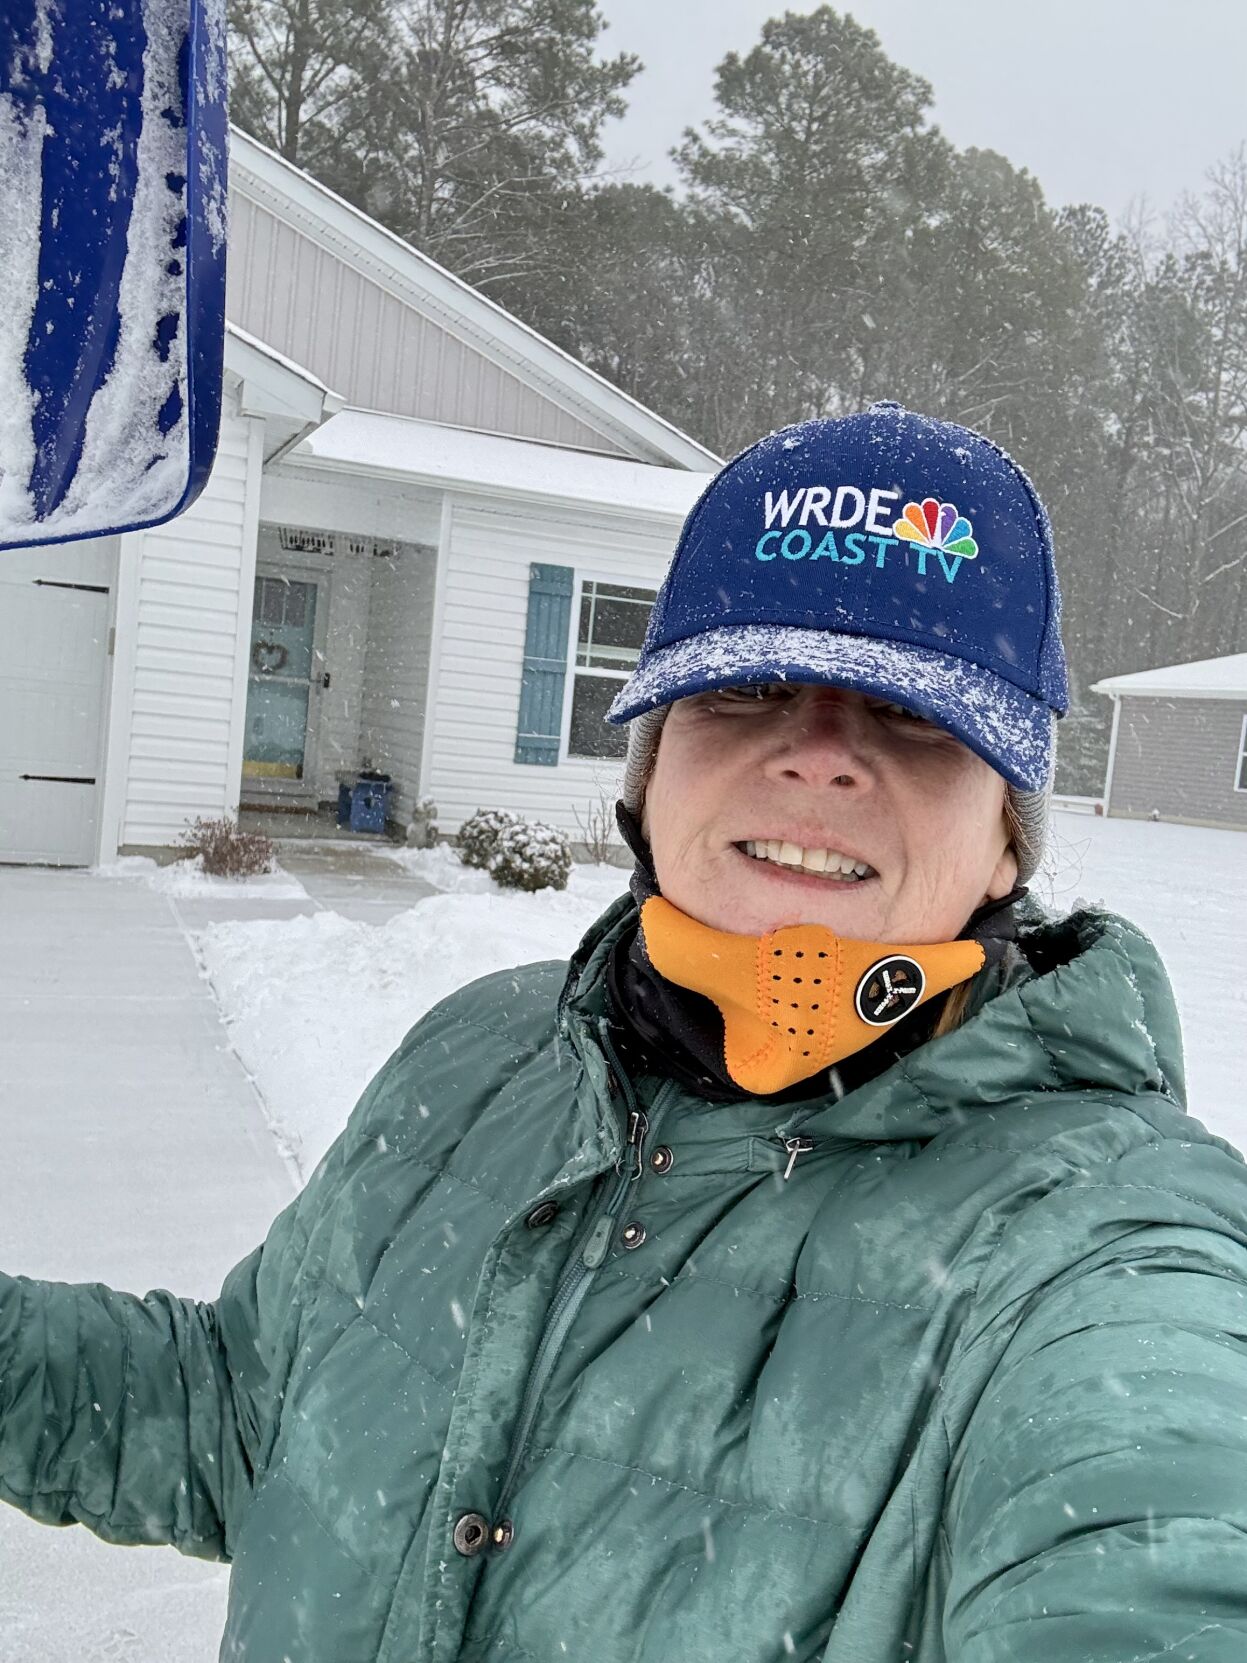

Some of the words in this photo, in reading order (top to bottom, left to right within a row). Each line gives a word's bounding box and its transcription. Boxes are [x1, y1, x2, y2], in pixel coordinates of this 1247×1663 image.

[764, 486, 899, 536] WRDE
[755, 529, 899, 569] COAST
[909, 542, 963, 584] TV
